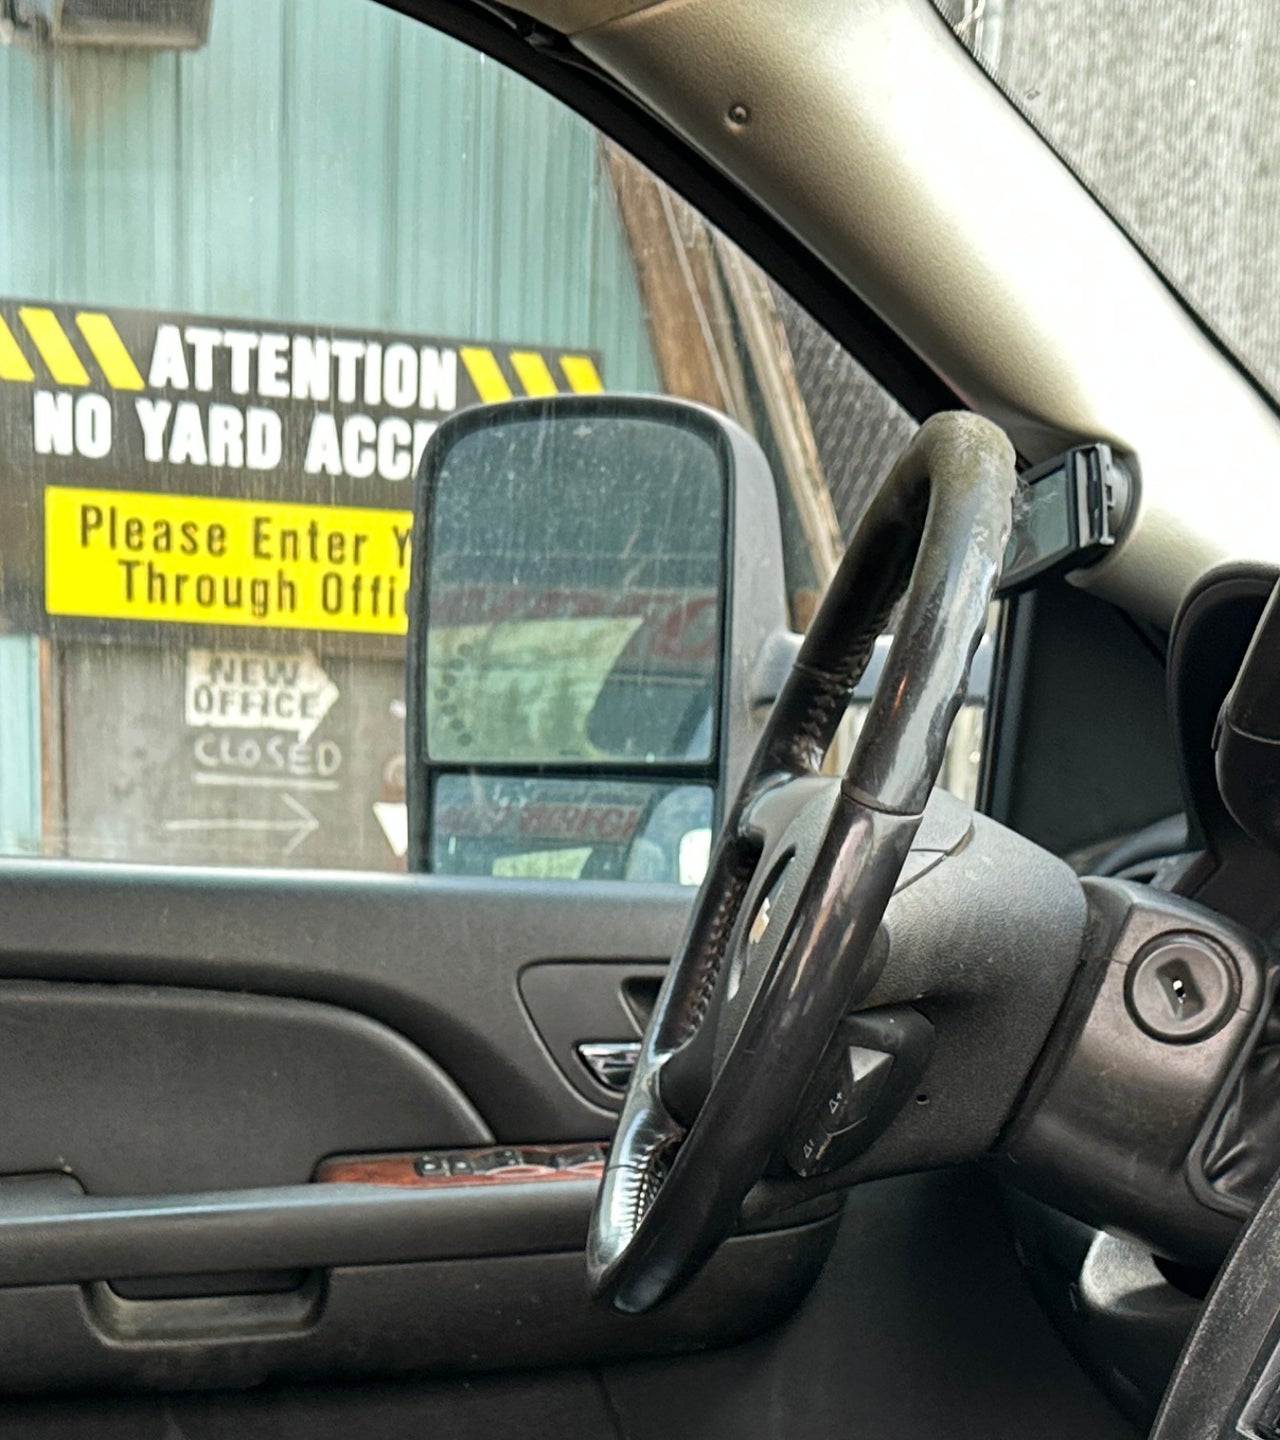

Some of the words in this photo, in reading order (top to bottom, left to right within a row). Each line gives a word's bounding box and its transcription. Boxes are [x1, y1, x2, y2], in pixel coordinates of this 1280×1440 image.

[148, 323, 458, 411] ATTENTION
[33, 391, 113, 459] NO
[135, 398, 283, 470] YARD
[80, 504, 227, 557] Please
[253, 516, 369, 566] Enter
[118, 558, 297, 619] Through
[321, 571, 408, 619] Offi
[193, 682, 320, 721] OFFICE
[209, 655, 300, 687] NEW
[194, 734, 343, 777] CLOSED
